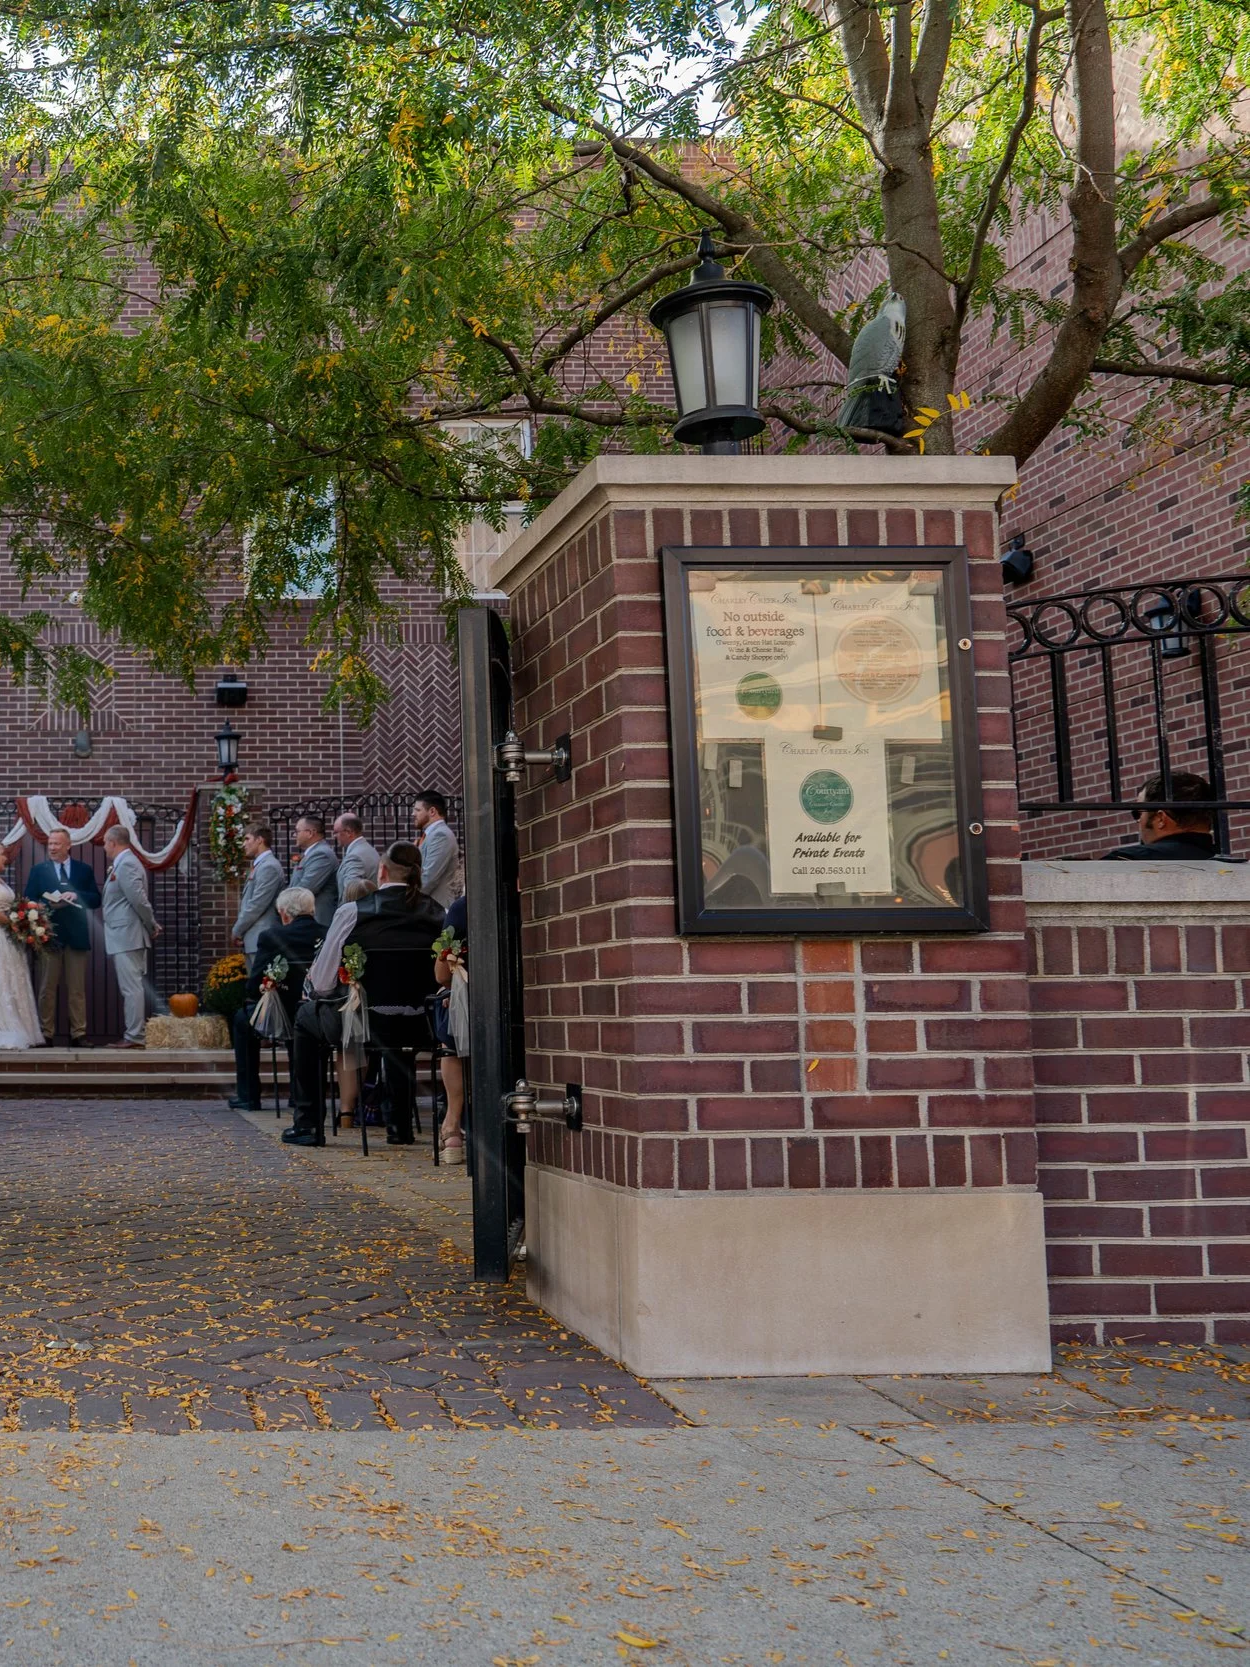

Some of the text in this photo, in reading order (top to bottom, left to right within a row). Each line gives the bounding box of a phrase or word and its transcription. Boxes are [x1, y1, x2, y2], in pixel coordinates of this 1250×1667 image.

[723, 611, 785, 622] No outside
[706, 626, 805, 640] food & beverages
[795, 831, 862, 845] Available for
[792, 847, 866, 858] Private Events
[792, 867, 867, 875] Call 260.563.0111
